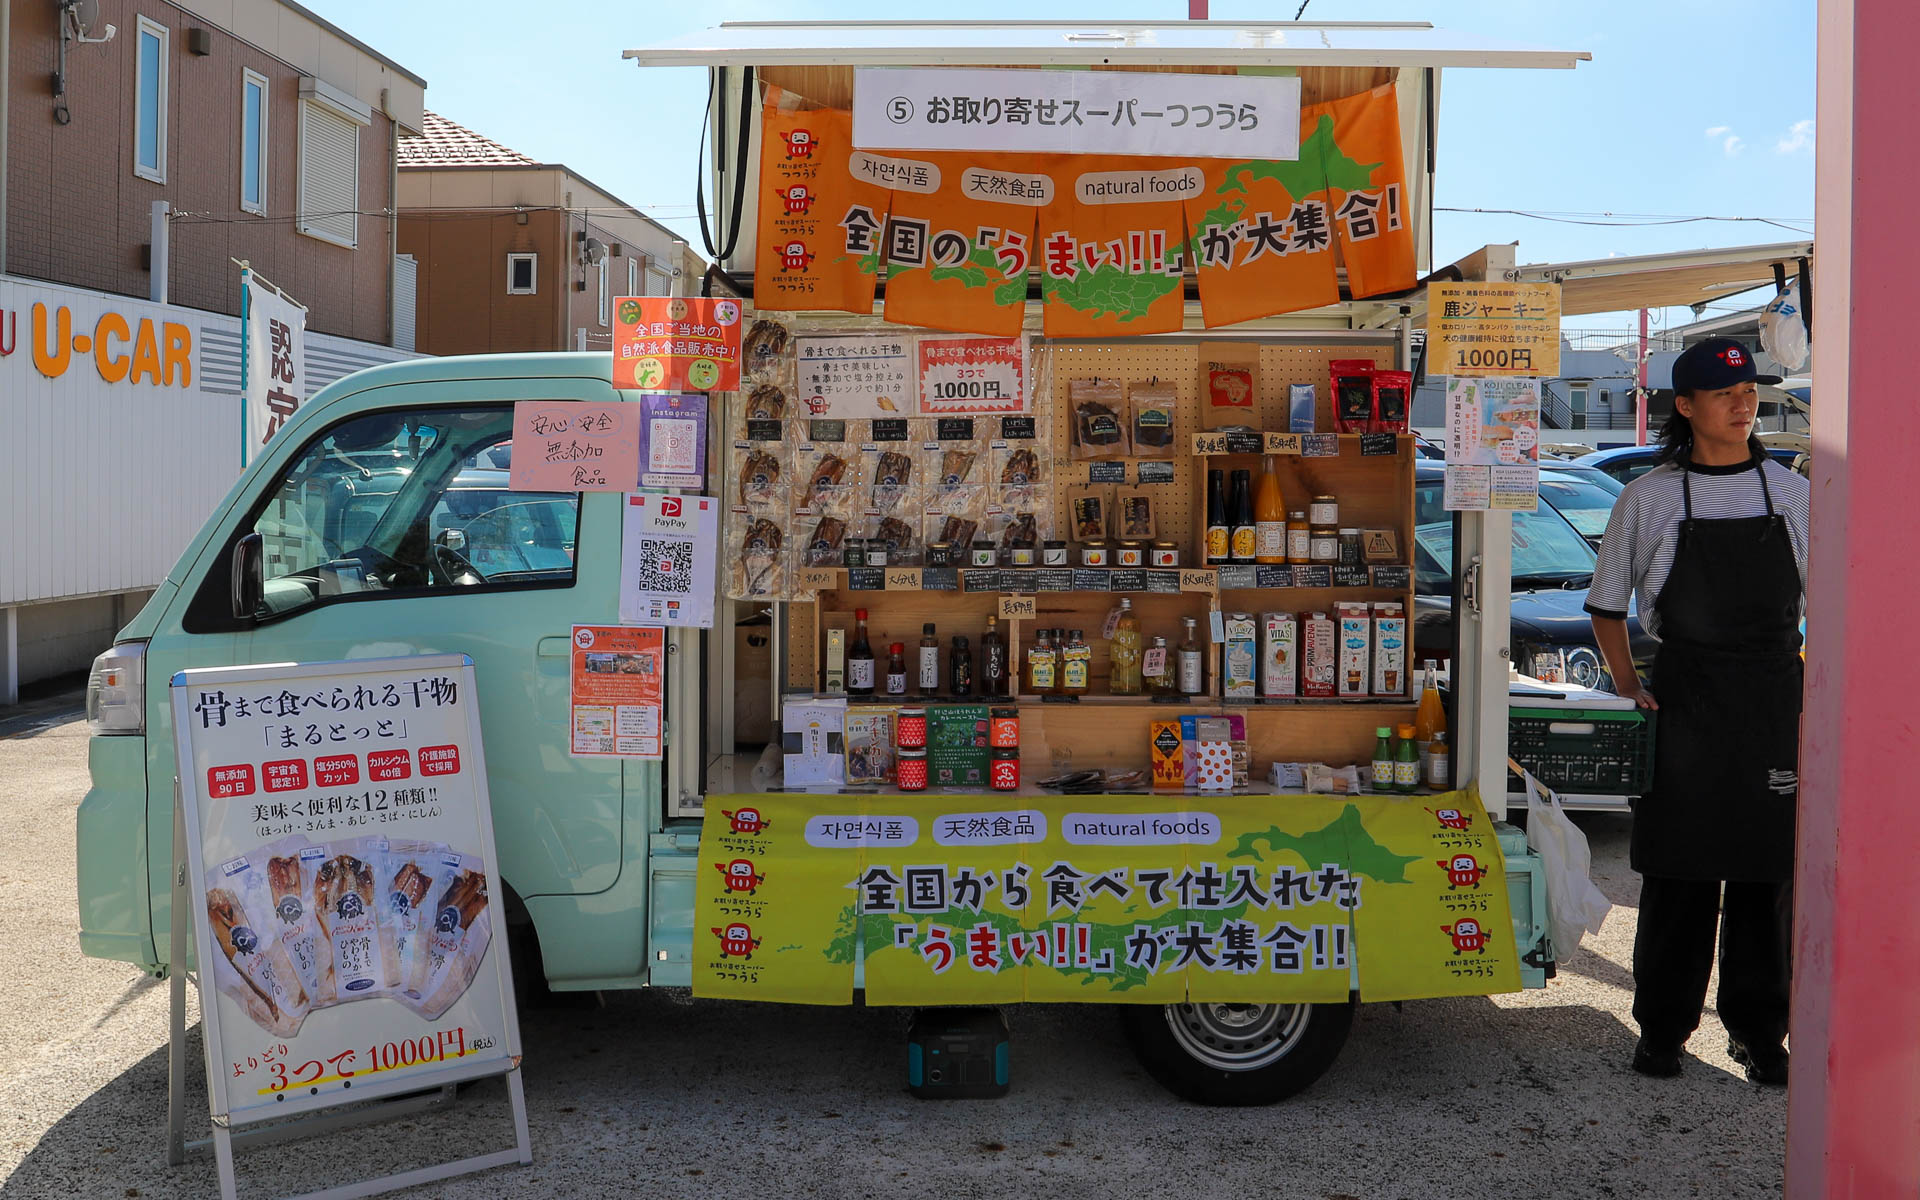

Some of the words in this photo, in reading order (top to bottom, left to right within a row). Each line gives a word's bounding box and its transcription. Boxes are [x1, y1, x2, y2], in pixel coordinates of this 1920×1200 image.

[926, 96, 1259, 131] お取り寄せスーパーつつうら
[781, 168, 818, 180] つつうら
[862, 159, 929, 187] 자연식품
[970, 174, 1045, 199] 天然食品
[1085, 176, 1145, 196] natural
[1149, 173, 1197, 193] foods
[779, 225, 815, 236] つつうら
[777, 282, 815, 293] つつうら
[1443, 300, 1545, 318] 鹿ジャーキー
[635, 322, 721, 338] 全国ご当地の
[32, 302, 192, 388] U-CAR
[622, 340, 736, 360] 自然派食品販売中!
[805, 343, 902, 358] 骨まで食べれる干物
[926, 345, 1017, 359] 骨まで食べれる干物
[1456, 349, 1532, 369] 1000円
[956, 368, 986, 379] 3つで
[933, 381, 1001, 400] 1000円
[1484, 382, 1503, 390] KOJI
[1506, 382, 1534, 390] CLEAR
[545, 440, 603, 463] 無添加
[570, 465, 607, 487] 食品
[654, 517, 687, 529] PayPay
[888, 574, 919, 587] 大分県
[1182, 572, 1215, 588] 秋田県
[1002, 599, 1034, 615] 長野県
[1306, 623, 1315, 667] PRIMAVENA
[194, 677, 457, 729] 骨まで食べられる干物
[263, 719, 409, 749] 「まるとっと」
[368, 754, 410, 768] カルシウム
[420, 748, 457, 761] 介護施設
[268, 763, 300, 776] 宇宙食
[315, 758, 357, 773] 塩分50%
[379, 766, 402, 779] 40倍
[425, 760, 454, 774] で採用
[214, 768, 248, 782] 無添加
[322, 771, 351, 784] カット
[820, 821, 904, 840] 자연식품
[943, 815, 1035, 839] 天然食品
[1074, 820, 1146, 837] natural
[1152, 818, 1210, 837] foods
[724, 845, 766, 856] つつうら
[1440, 838, 1483, 849] つつうら
[858, 863, 1360, 914] 全国から食べて仕入れた
[719, 907, 762, 919] つつうら
[1446, 901, 1488, 912] つつうら
[340, 939, 352, 970] ひもの
[349, 937, 363, 973] やわらか
[358, 936, 372, 967] 骨まで
[716, 971, 759, 984] つつうら
[1451, 967, 1494, 978] つつうら
[232, 1043, 289, 1078] よりどり
[270, 1049, 355, 1092] 3つで
[366, 1027, 465, 1073] 1000円
